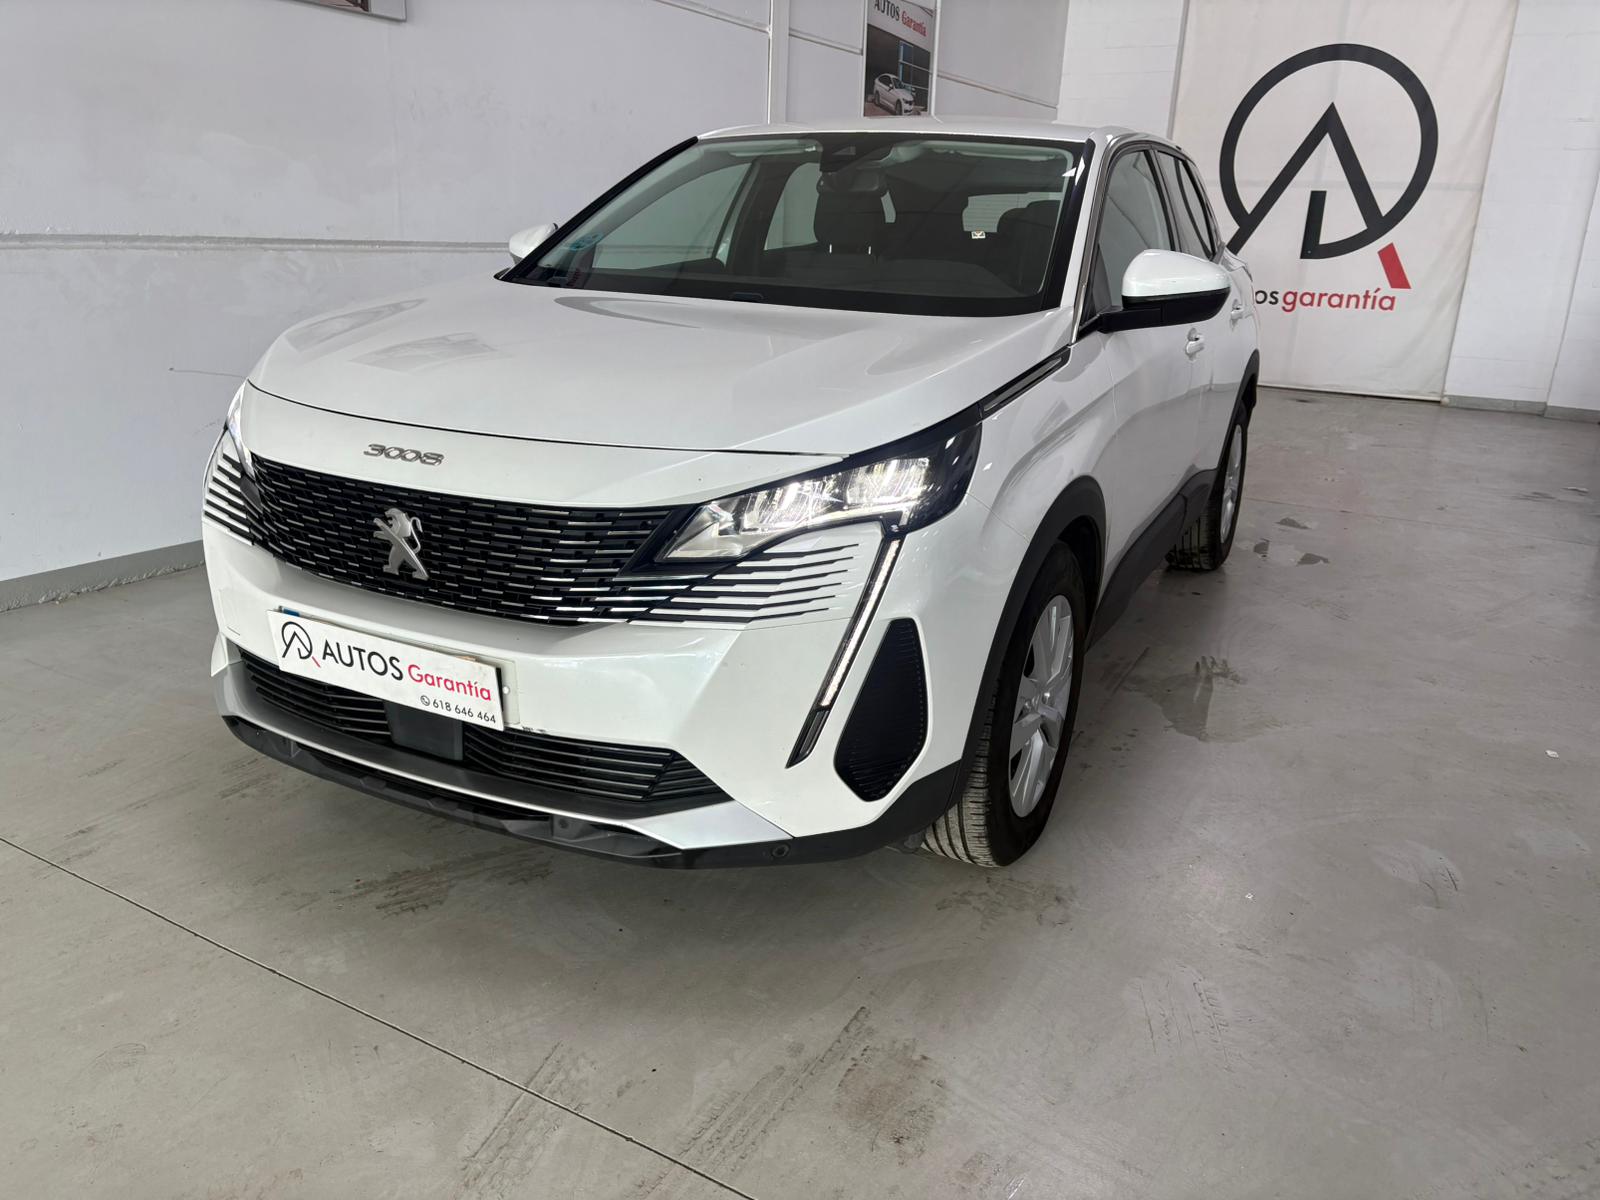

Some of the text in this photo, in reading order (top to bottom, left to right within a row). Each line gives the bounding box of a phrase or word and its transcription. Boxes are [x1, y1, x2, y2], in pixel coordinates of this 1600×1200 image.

[874, 0, 899, 21] AUTOS
[363, 443, 445, 466] 3008
[322, 639, 491, 701] AUTOS Garantía
[432, 698, 496, 724] 618 646 464
